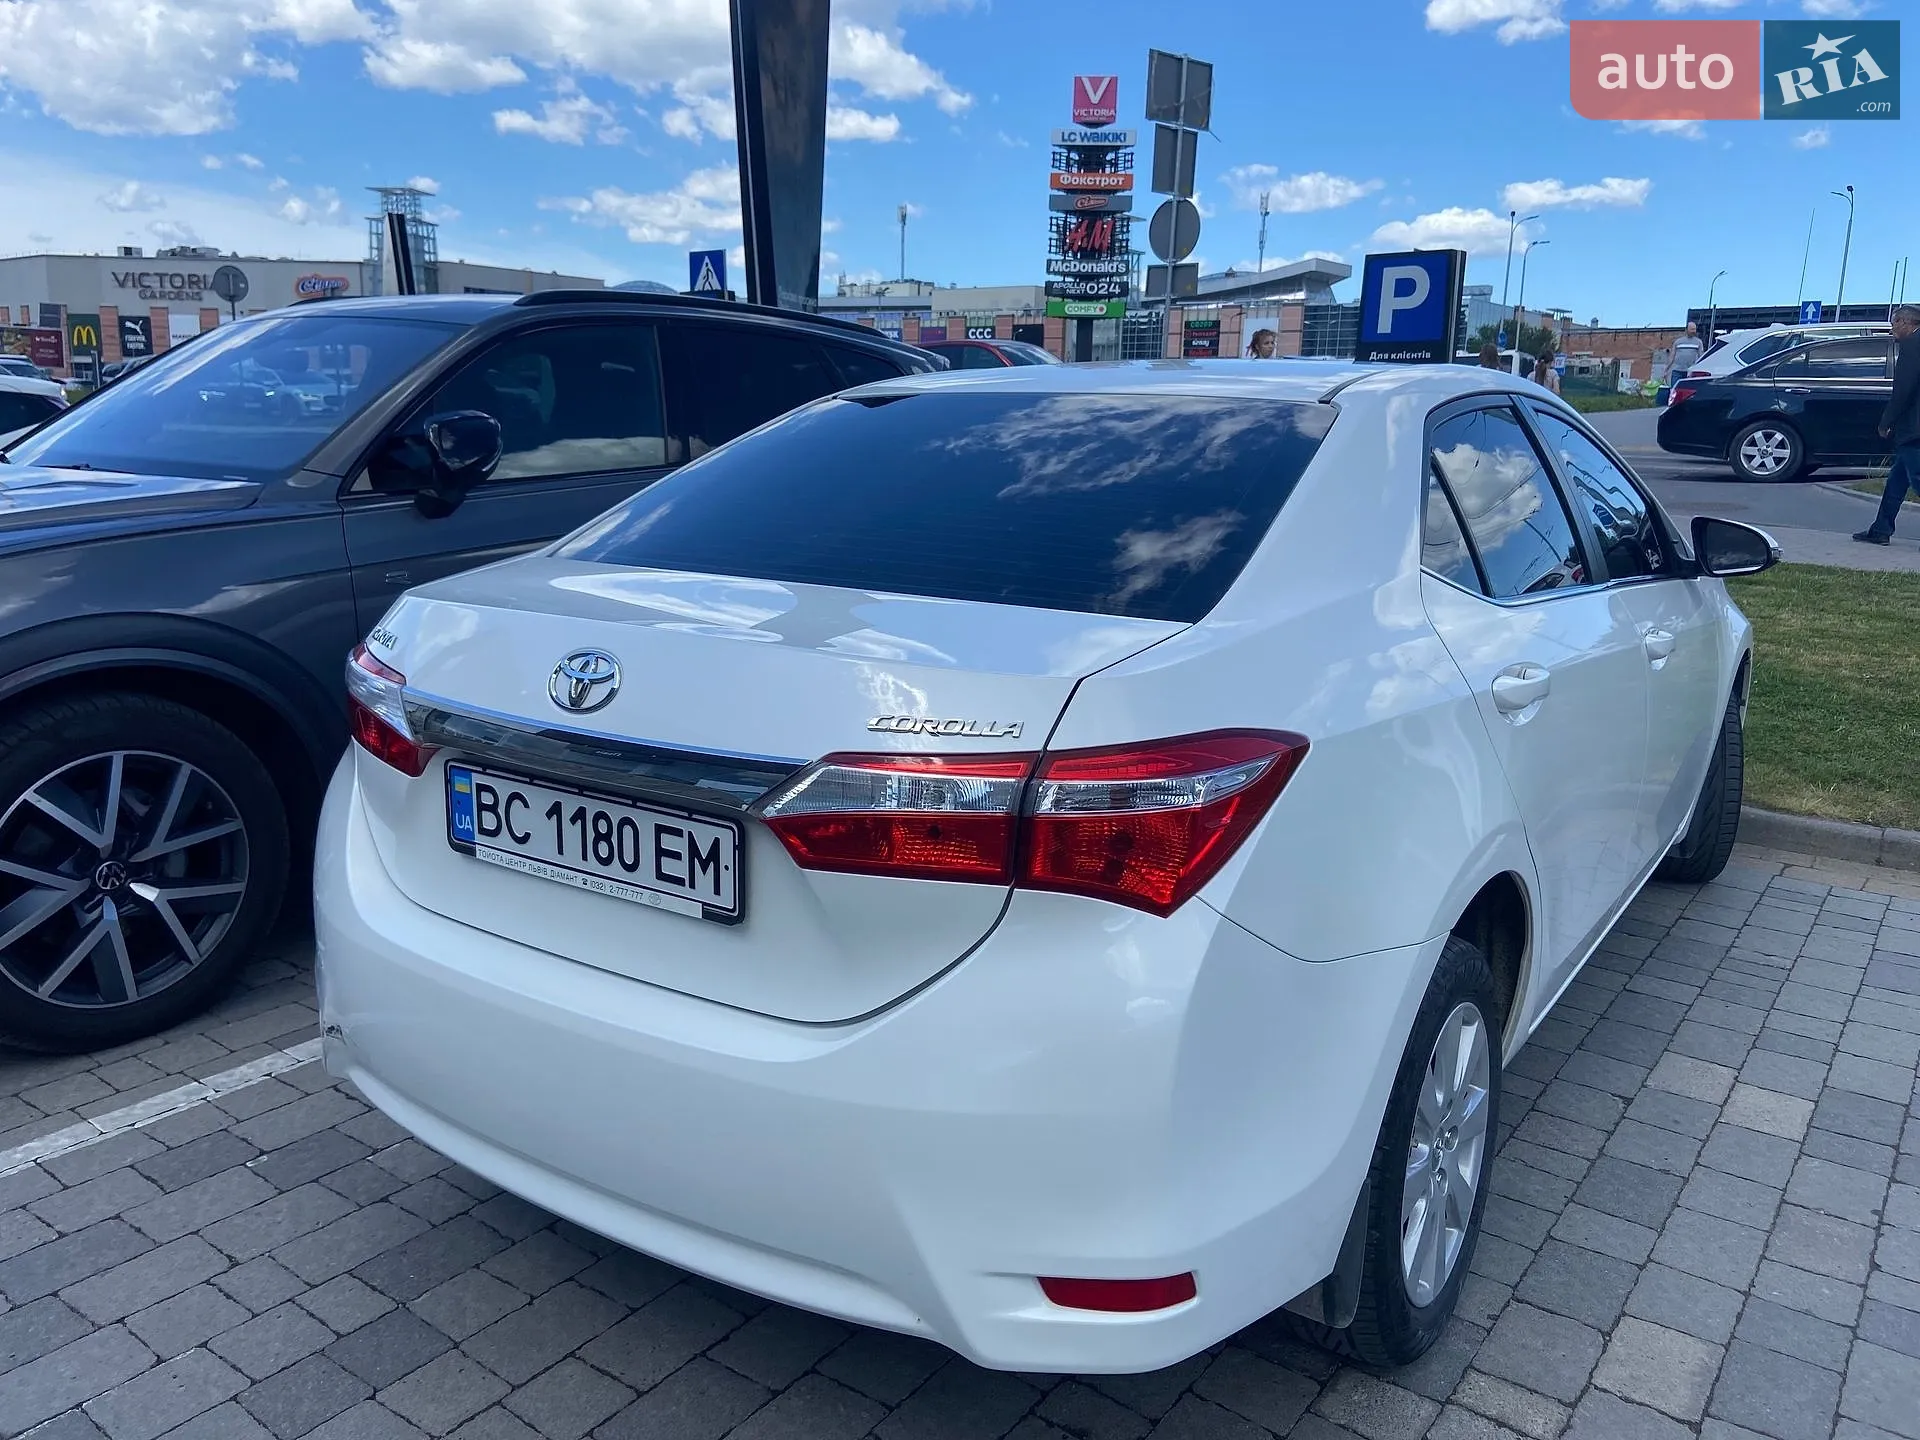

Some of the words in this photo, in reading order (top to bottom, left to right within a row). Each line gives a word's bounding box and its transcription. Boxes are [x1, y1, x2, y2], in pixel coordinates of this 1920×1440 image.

[1074, 109, 1116, 117] VICTORIA
[1061, 132, 1078, 142] LC
[1060, 174, 1125, 187] Фокстрот
[1050, 261, 1127, 273] McDonald's
[111, 271, 215, 290] VICTORI
[1053, 282, 1086, 290] APOLLO
[1086, 283, 1121, 294] 024
[139, 289, 204, 302] GARDENS
[1377, 265, 1431, 334] P
[1066, 305, 1098, 314] COMFY
[968, 328, 992, 339] CCC
[1369, 351, 1389, 360] Для
[1391, 350, 1431, 359] клієнтів
[866, 714, 1025, 738] COROLLA
[455, 812, 473, 832] UA
[475, 782, 531, 845] BC
[545, 800, 640, 873] 1180
[653, 822, 721, 896] EM
[506, 858, 527, 869] ЦЕНТР
[550, 869, 578, 881] ДІАМАНТ
[609, 885, 644, 900] 2-777-777
